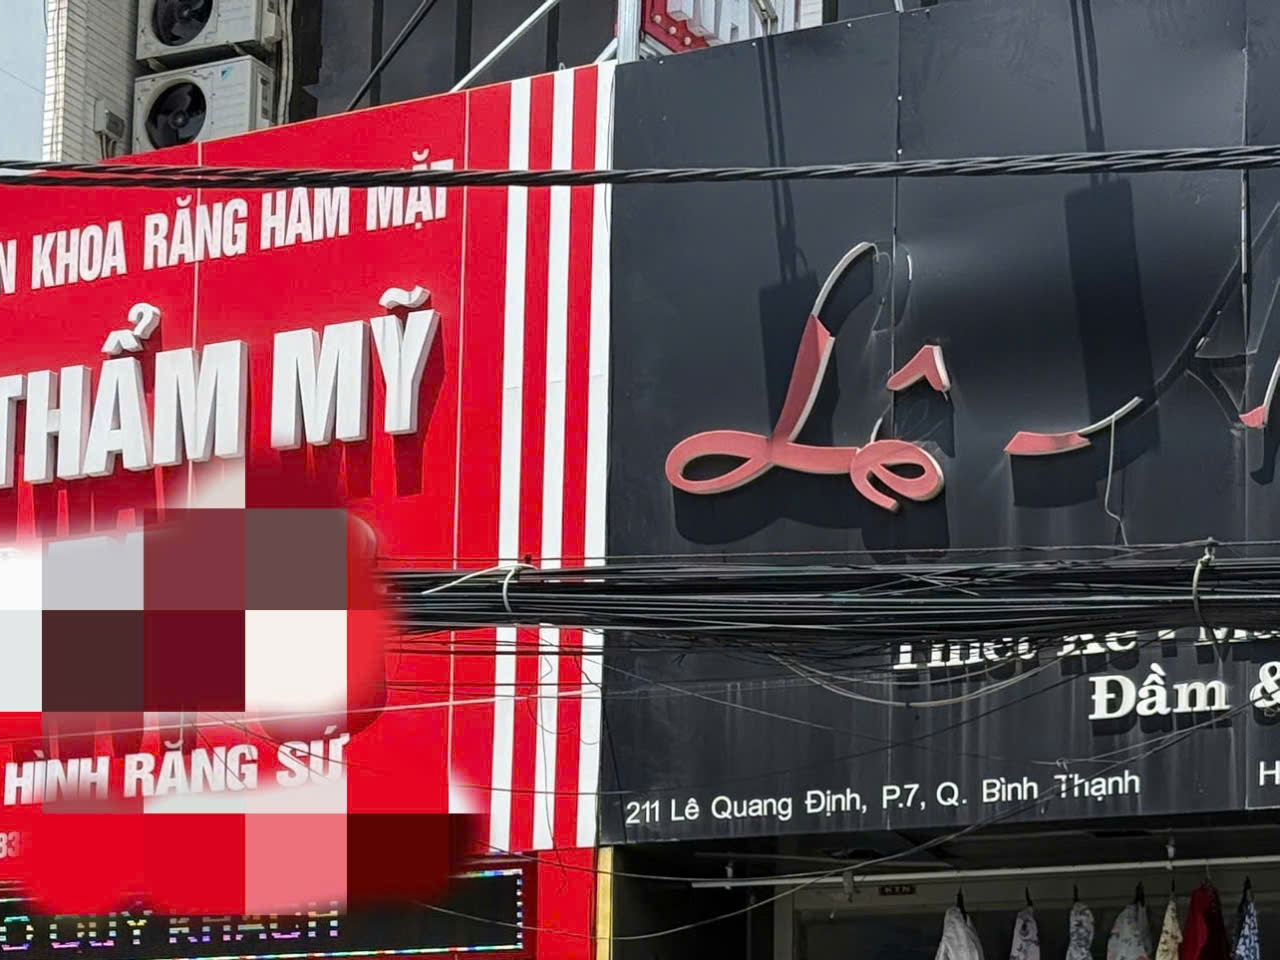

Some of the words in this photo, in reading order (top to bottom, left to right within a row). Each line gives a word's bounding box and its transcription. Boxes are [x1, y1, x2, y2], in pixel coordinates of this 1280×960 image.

[31, 220, 127, 291] KHOA
[143, 195, 247, 268] RĂNG
[270, 285, 440, 452] MỸ
[1088, 662, 1232, 720] Đầm
[124, 740, 257, 798] RĂNG
[625, 800, 660, 824] 211
[671, 797, 700, 821] Lê
[711, 795, 793, 821] Quang
[804, 787, 868, 817] Định,
[882, 784, 927, 811] P.7,
[936, 781, 968, 806] Q.
[982, 776, 1038, 803] Bình
[1054, 770, 1140, 802] Thạnh
